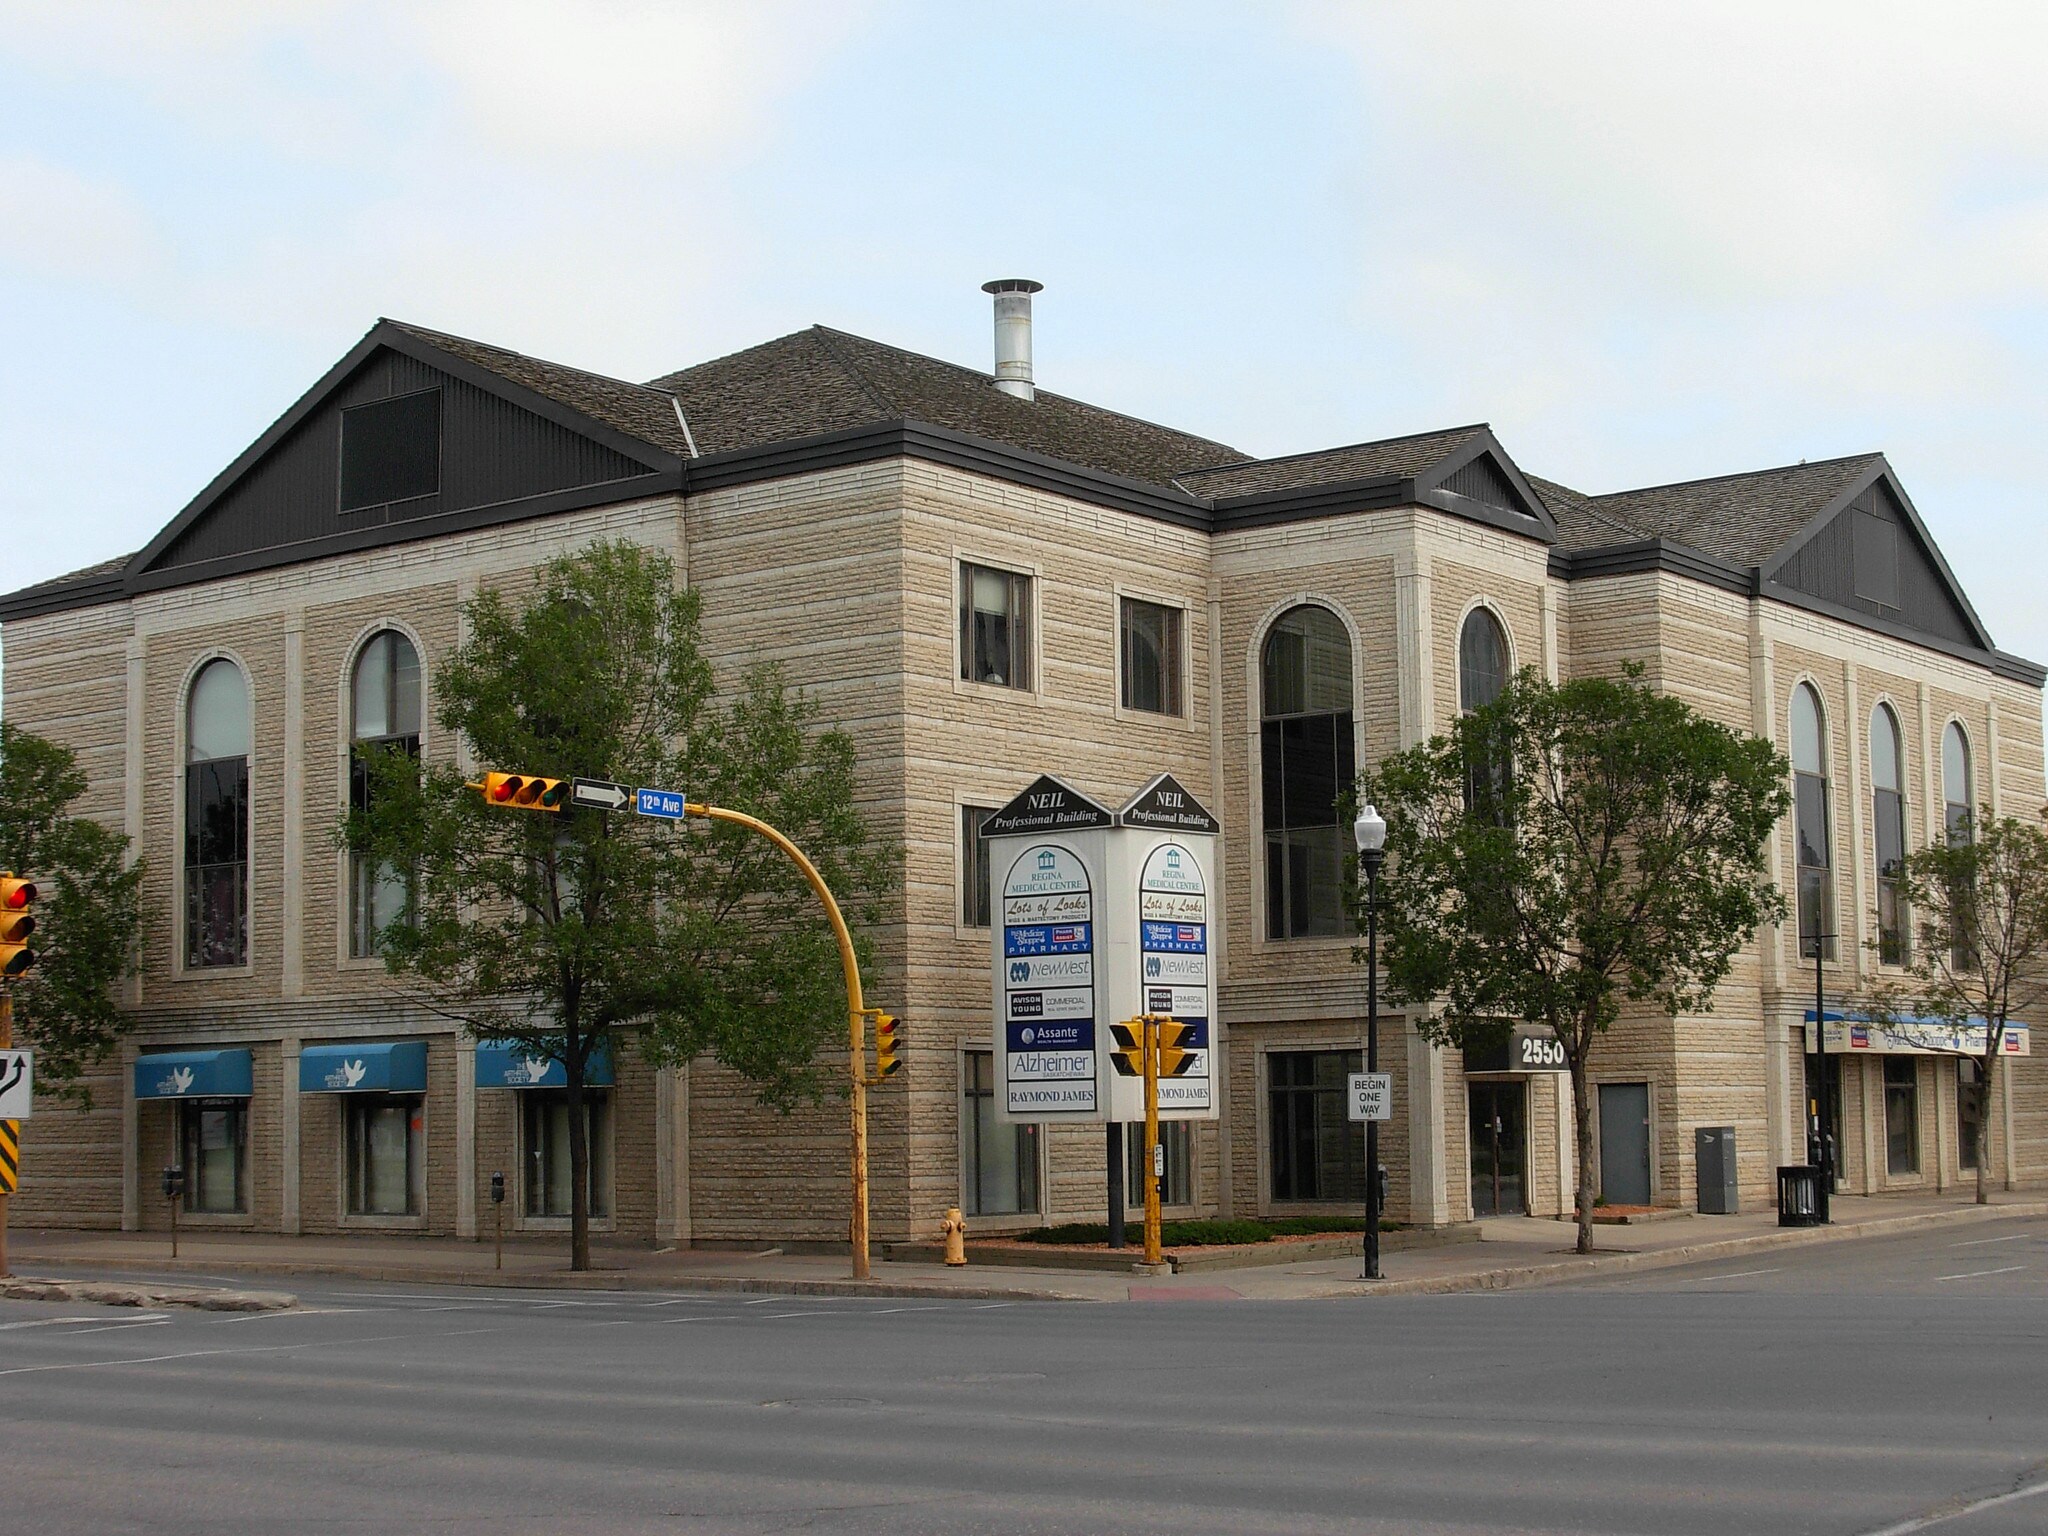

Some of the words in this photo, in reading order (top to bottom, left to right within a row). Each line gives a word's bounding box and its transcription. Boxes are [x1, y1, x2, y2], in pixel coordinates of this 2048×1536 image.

[642, 794, 661, 810] 12th
[662, 797, 680, 813] Ave
[1027, 792, 1066, 810] NEIL
[1156, 791, 1184, 808] NEIL
[995, 813, 1054, 830] Professional
[1056, 811, 1098, 823] Building
[1132, 808, 1177, 823] Professional
[1178, 813, 1210, 829] Building
[1031, 871, 1063, 882] REGINA
[1162, 870, 1186, 880] REGINA
[1012, 883, 1049, 893] MEDICAL
[1050, 880, 1082, 891] CENTRE
[1147, 879, 1175, 889] MEDICAL
[1176, 881, 1200, 891] CENTRE
[1007, 900, 1032, 915] Lots
[1037, 899, 1050, 916] of
[1053, 896, 1088, 912] Looks
[1143, 895, 1162, 910] Lots
[1166, 897, 1175, 916] of
[1178, 898, 1202, 913] Looks
[1009, 943, 1088, 954] PHARMACY
[1145, 941, 1203, 950] PHARMACY
[1031, 961, 1089, 977] NewWest
[1162, 960, 1204, 975] NewWest
[1012, 996, 1041, 1004] AVISON
[1012, 1005, 1042, 1013] YOUNG
[1037, 1026, 1078, 1038] Assante
[1522, 1038, 1564, 1064] 2550
[1014, 1052, 1089, 1073] Alzheimer
[1354, 1080, 1386, 1090] BEGIN
[1010, 1091, 1060, 1102] RAYMOND
[1061, 1090, 1094, 1101] JAMES
[1156, 1088, 1184, 1099] YMOND
[1185, 1088, 1208, 1099] JAMES
[1359, 1092, 1381, 1102] ONE
[1359, 1104, 1380, 1114] WAY
